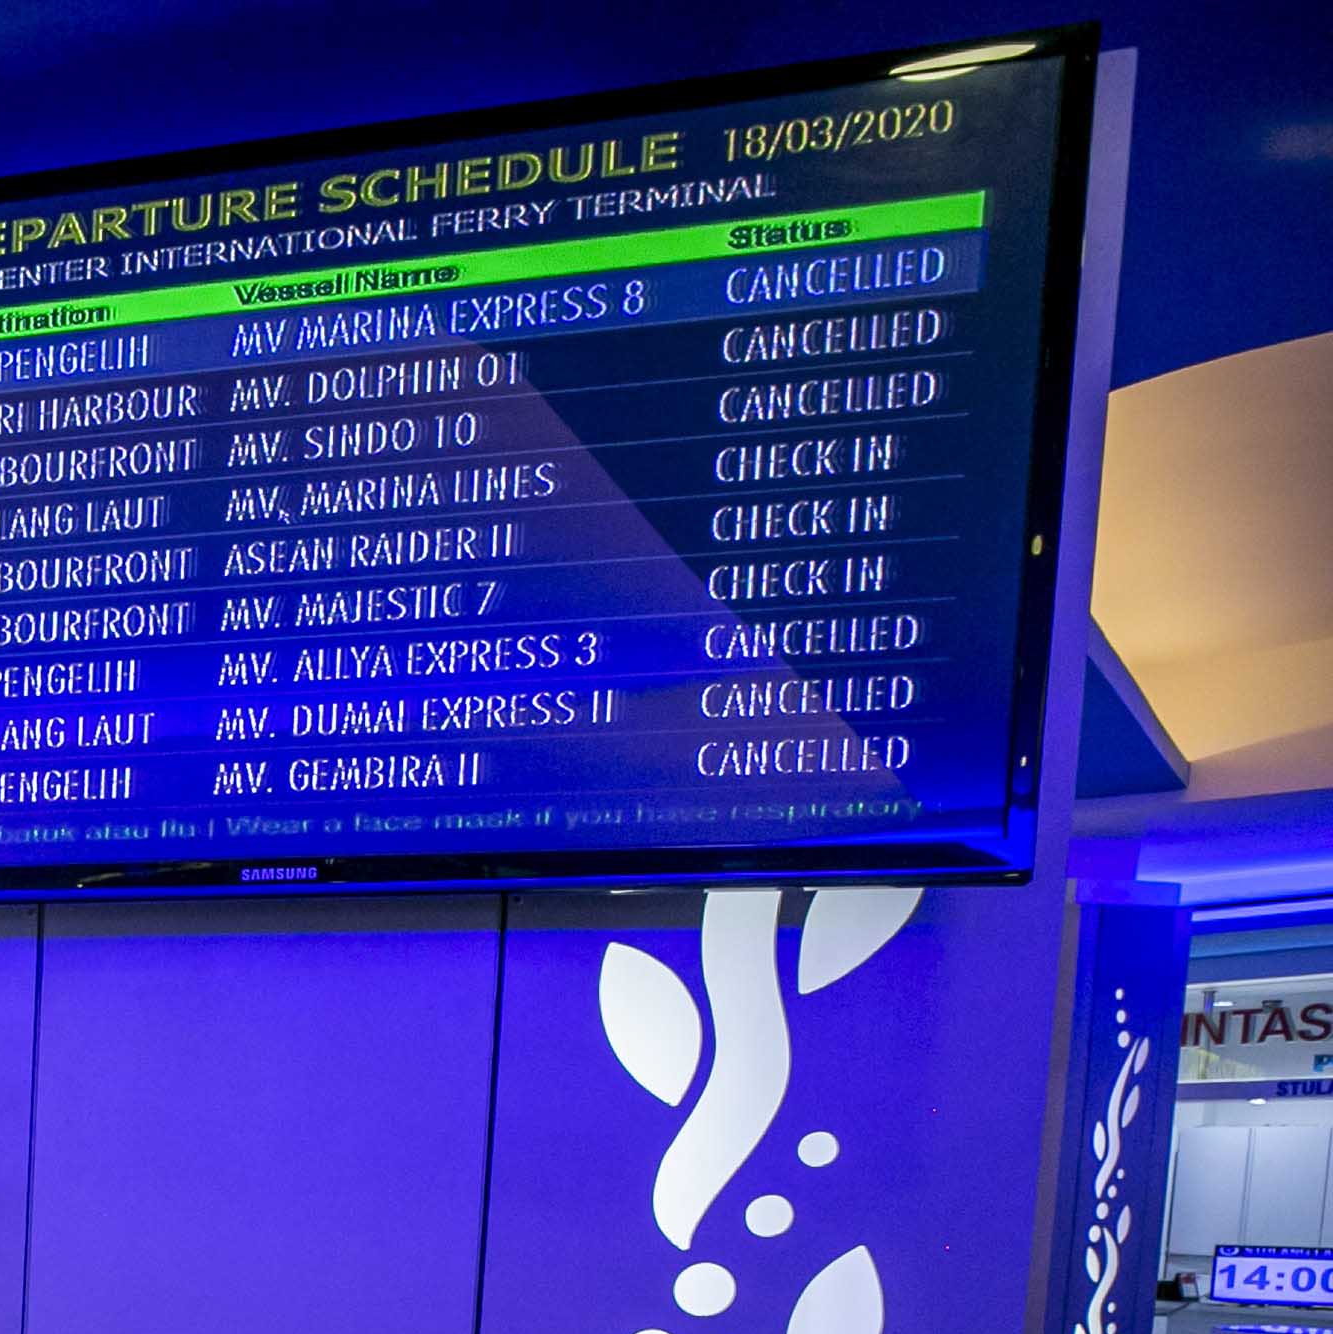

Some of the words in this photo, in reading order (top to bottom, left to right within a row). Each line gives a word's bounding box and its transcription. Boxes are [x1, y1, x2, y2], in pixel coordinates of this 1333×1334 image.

[724, 100, 955, 162] 18/03/2020
[318, 131, 680, 214] SCHEDULE
[121, 219, 418, 275] INTERNATIONAL
[432, 198, 558, 239] FERRY
[567, 173, 777, 221] TERMINAL
[235, 273, 347, 305] Vessel
[355, 266, 458, 293] Name
[728, 218, 853, 250] Status
[232, 319, 285, 357] MV
[297, 304, 436, 350] MARINA
[450, 283, 608, 334] EXPRESS
[623, 280, 645, 315] 8
[726, 247, 945, 304] CANCELLED
[39, 385, 198, 431] HARBOUR
[230, 375, 290, 412] MV.
[309, 357, 460, 404] DOLPHIN
[477, 352, 518, 387] 01
[723, 309, 942, 363] CANCELLED
[228, 430, 287, 467] MV.
[305, 417, 416, 459] SINDO
[435, 411, 477, 448] 10
[719, 370, 936, 424] CANCELLED
[86, 495, 165, 532] LAUT
[301, 473, 440, 516] MARINA
[455, 462, 557, 504] LINES
[716, 440, 836, 482] CHECK
[853, 434, 893, 472] IN
[225, 537, 334, 576] ASEAN
[351, 527, 477, 568] RAIDER
[492, 523, 513, 557] II
[713, 500, 832, 542] CHECK
[850, 495, 888, 533] IN
[221, 596, 280, 632] MV.
[295, 582, 462, 627] MAJESTIC
[477, 581, 497, 616] 7
[708, 560, 827, 600] CHECK
[845, 555, 884, 592] IN
[218, 651, 278, 686] MV.
[293, 644, 393, 682] ALLYA
[407, 634, 561, 676] EXPRESS
[575, 632, 597, 666] 3
[705, 614, 919, 659] CANCELLED
[78, 712, 156, 747] LAUT
[216, 706, 275, 740] MV.
[293, 700, 405, 737] DUMAI
[422, 690, 576, 731] EXPRESS
[592, 689, 614, 723] II
[701, 675, 915, 718] CANCELLED
[213, 761, 273, 795] MV.
[289, 753, 444, 791] GEMBIRA
[458, 752, 480, 787] II
[697, 736, 910, 776] CANCELLED
[241, 867, 317, 881] SAMSUNG
[1276, 1080, 1333, 1097] STUL
